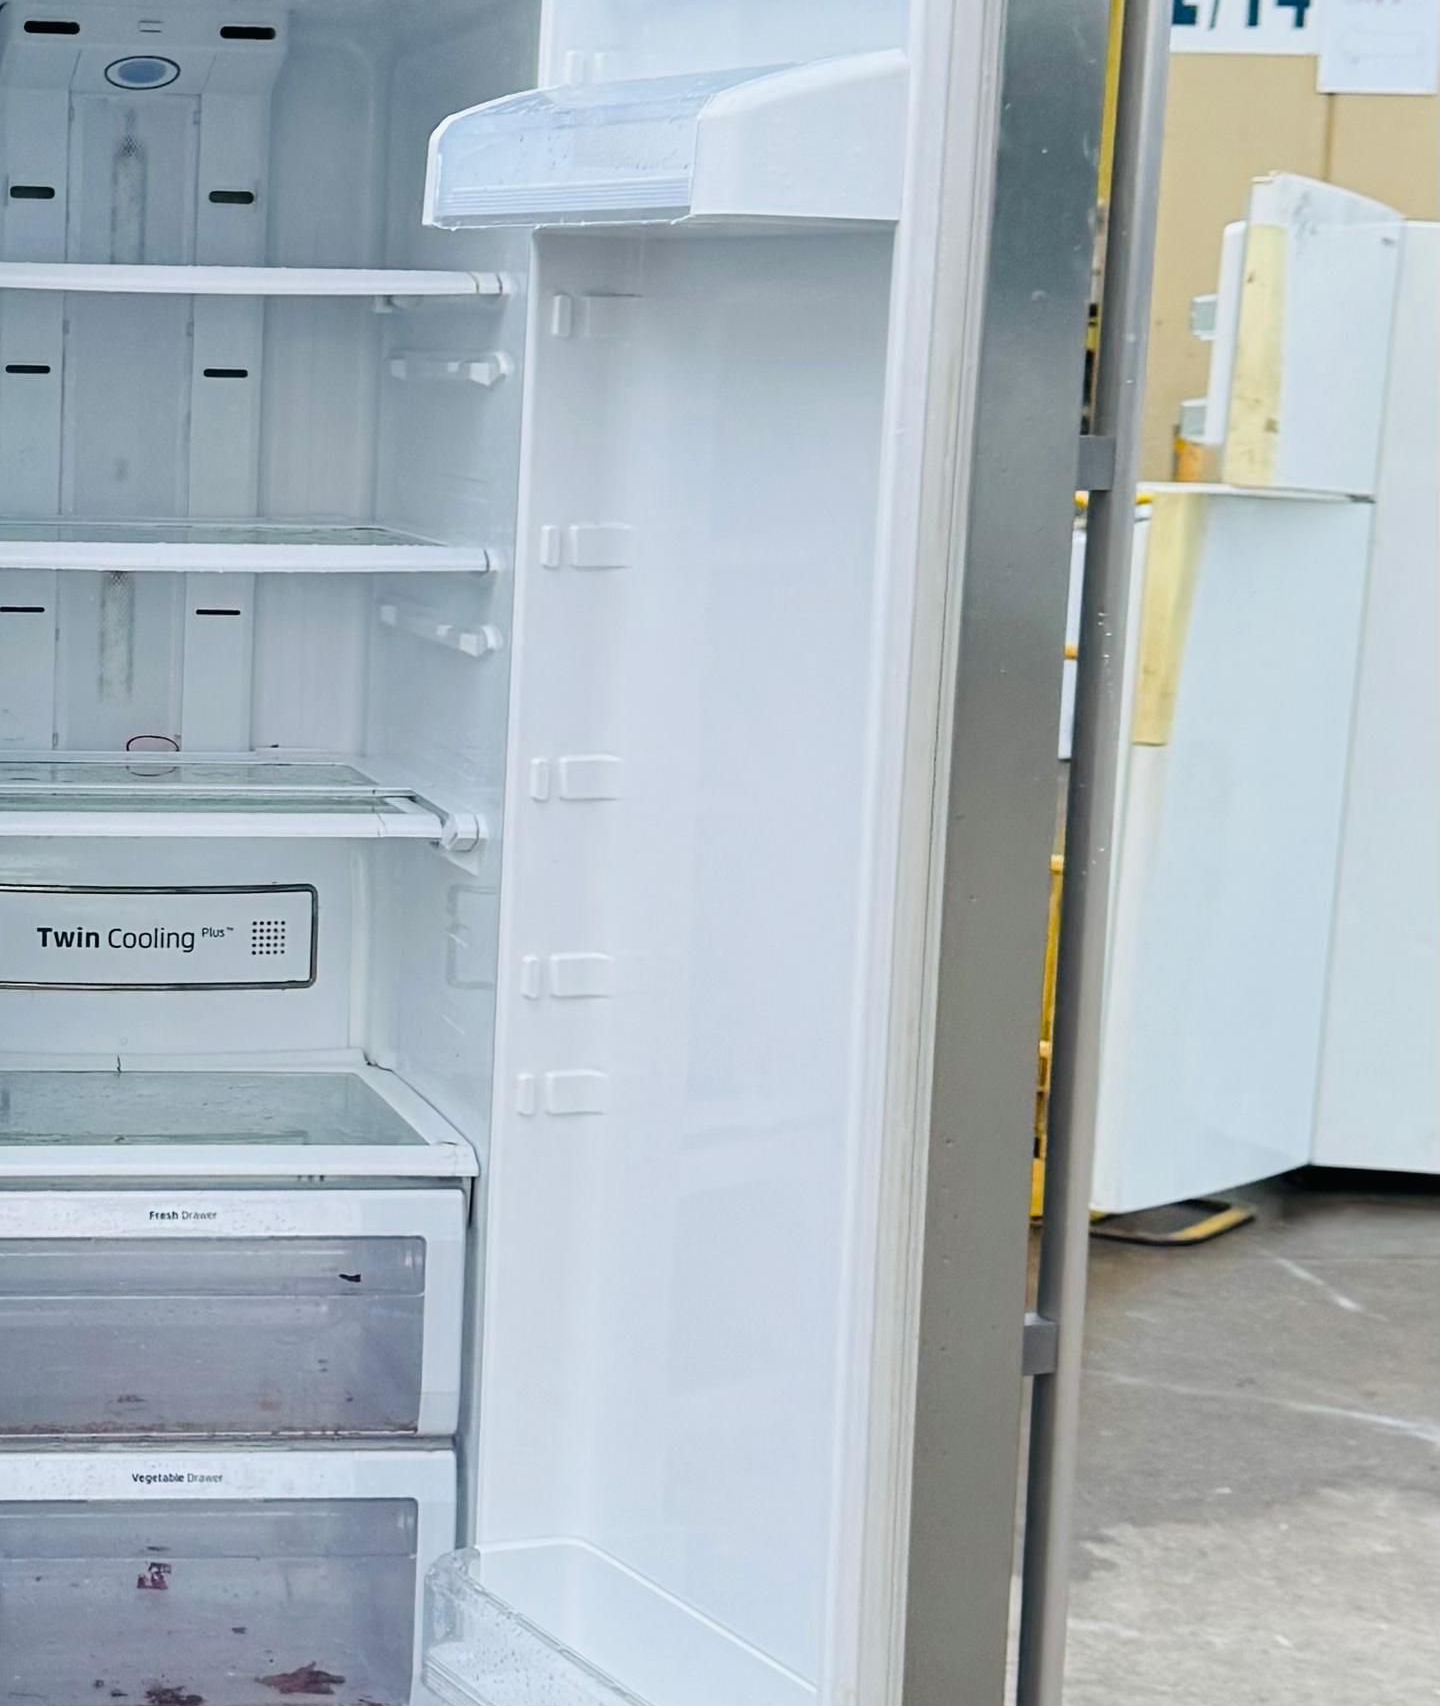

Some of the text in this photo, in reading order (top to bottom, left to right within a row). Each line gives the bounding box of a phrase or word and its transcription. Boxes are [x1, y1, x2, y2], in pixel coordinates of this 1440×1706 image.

[37, 926, 100, 948] Twin
[108, 927, 195, 953] Cooling
[148, 1210, 217, 1221] Fresh Drawer
[132, 1472, 224, 1485] Vegetable Drawer
